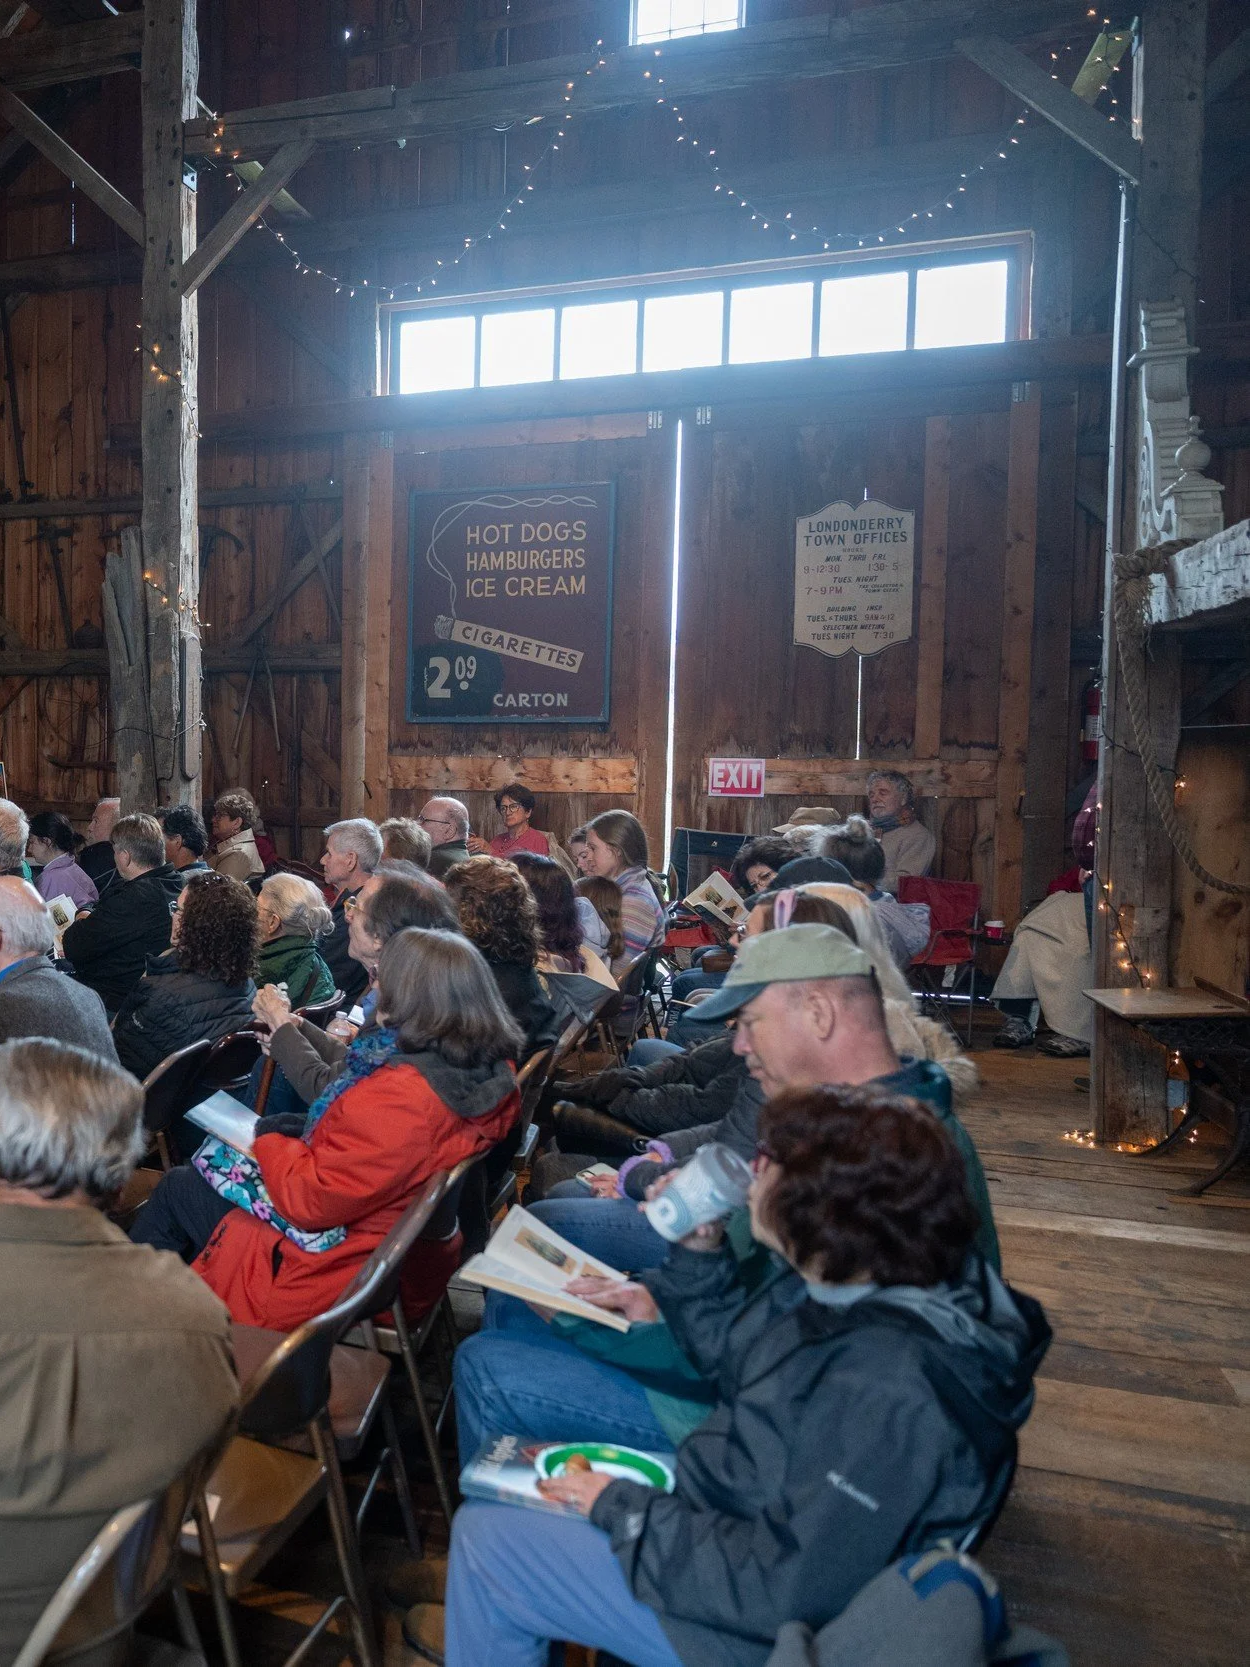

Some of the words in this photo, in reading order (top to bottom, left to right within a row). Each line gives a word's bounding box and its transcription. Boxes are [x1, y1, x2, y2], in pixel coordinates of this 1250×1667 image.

[466, 524, 513, 545] HOT
[521, 520, 587, 543] DOGS
[808, 517, 904, 533] LONDONDERRY
[804, 534, 846, 547] TOWN
[853, 531, 908, 545] OFFICES
[466, 549, 586, 571] HAMBURGERS
[466, 578, 496, 598] ICE
[505, 575, 586, 597] CREAM
[855, 575, 879, 583] NIGHT
[834, 632, 856, 640] NIGHT
[461, 626, 578, 669] CIGARETTES
[493, 693, 568, 707] CARTON
[713, 763, 761, 789] EXIT
